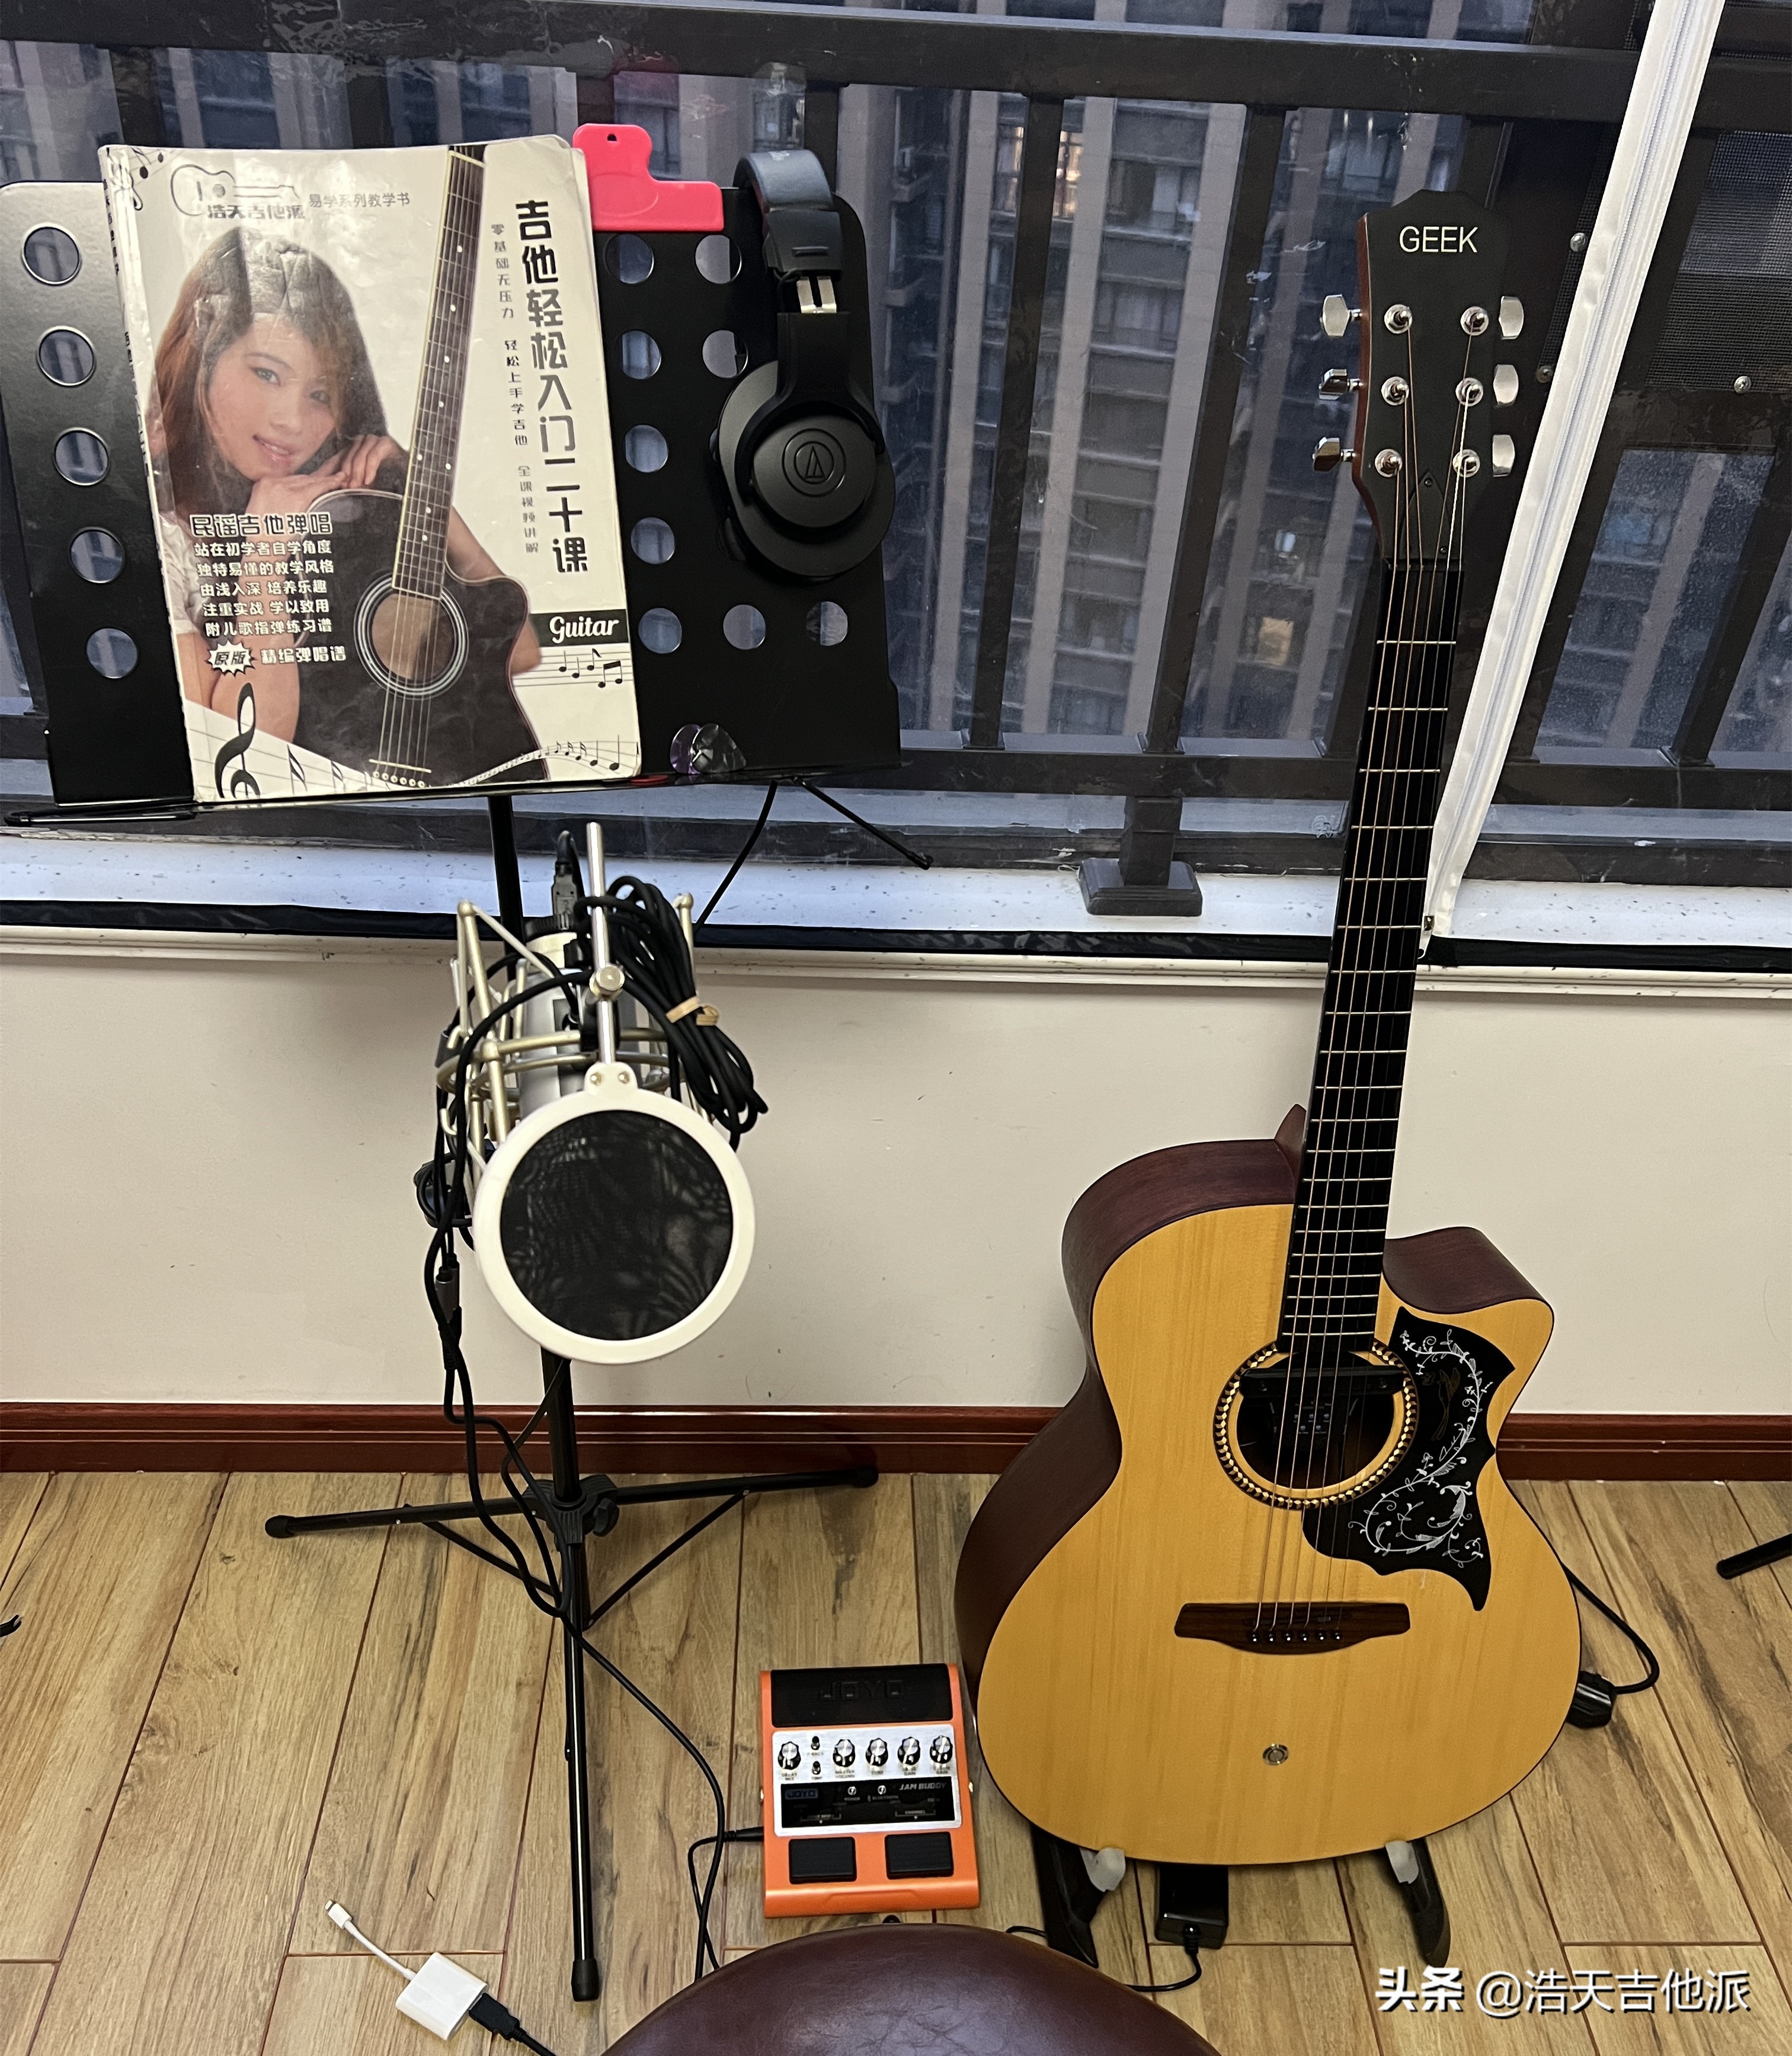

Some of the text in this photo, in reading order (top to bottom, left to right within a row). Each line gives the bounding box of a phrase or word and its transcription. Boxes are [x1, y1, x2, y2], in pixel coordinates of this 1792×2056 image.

[309, 193, 410, 208] 易学系列教学书
[1399, 226, 1479, 253] GEEK
[504, 340, 528, 446] 轻松上手学吉他
[515, 200, 588, 573] 吉他轻松入门二十课
[190, 512, 332, 538] 民谣吉他弹唱
[194, 539, 332, 557] 站在初学者自学角度
[197, 559, 334, 577] 独特易懂的教学风格
[200, 580, 327, 597] 由浅入深 培养乐趣
[203, 599, 329, 617] 注重实战 学以致用
[205, 618, 332, 637] 附儿歌指弹练习谱
[549, 616, 620, 644] Guitar
[214, 651, 247, 666] 原版
[261, 645, 347, 665] 精编弹唱谱
